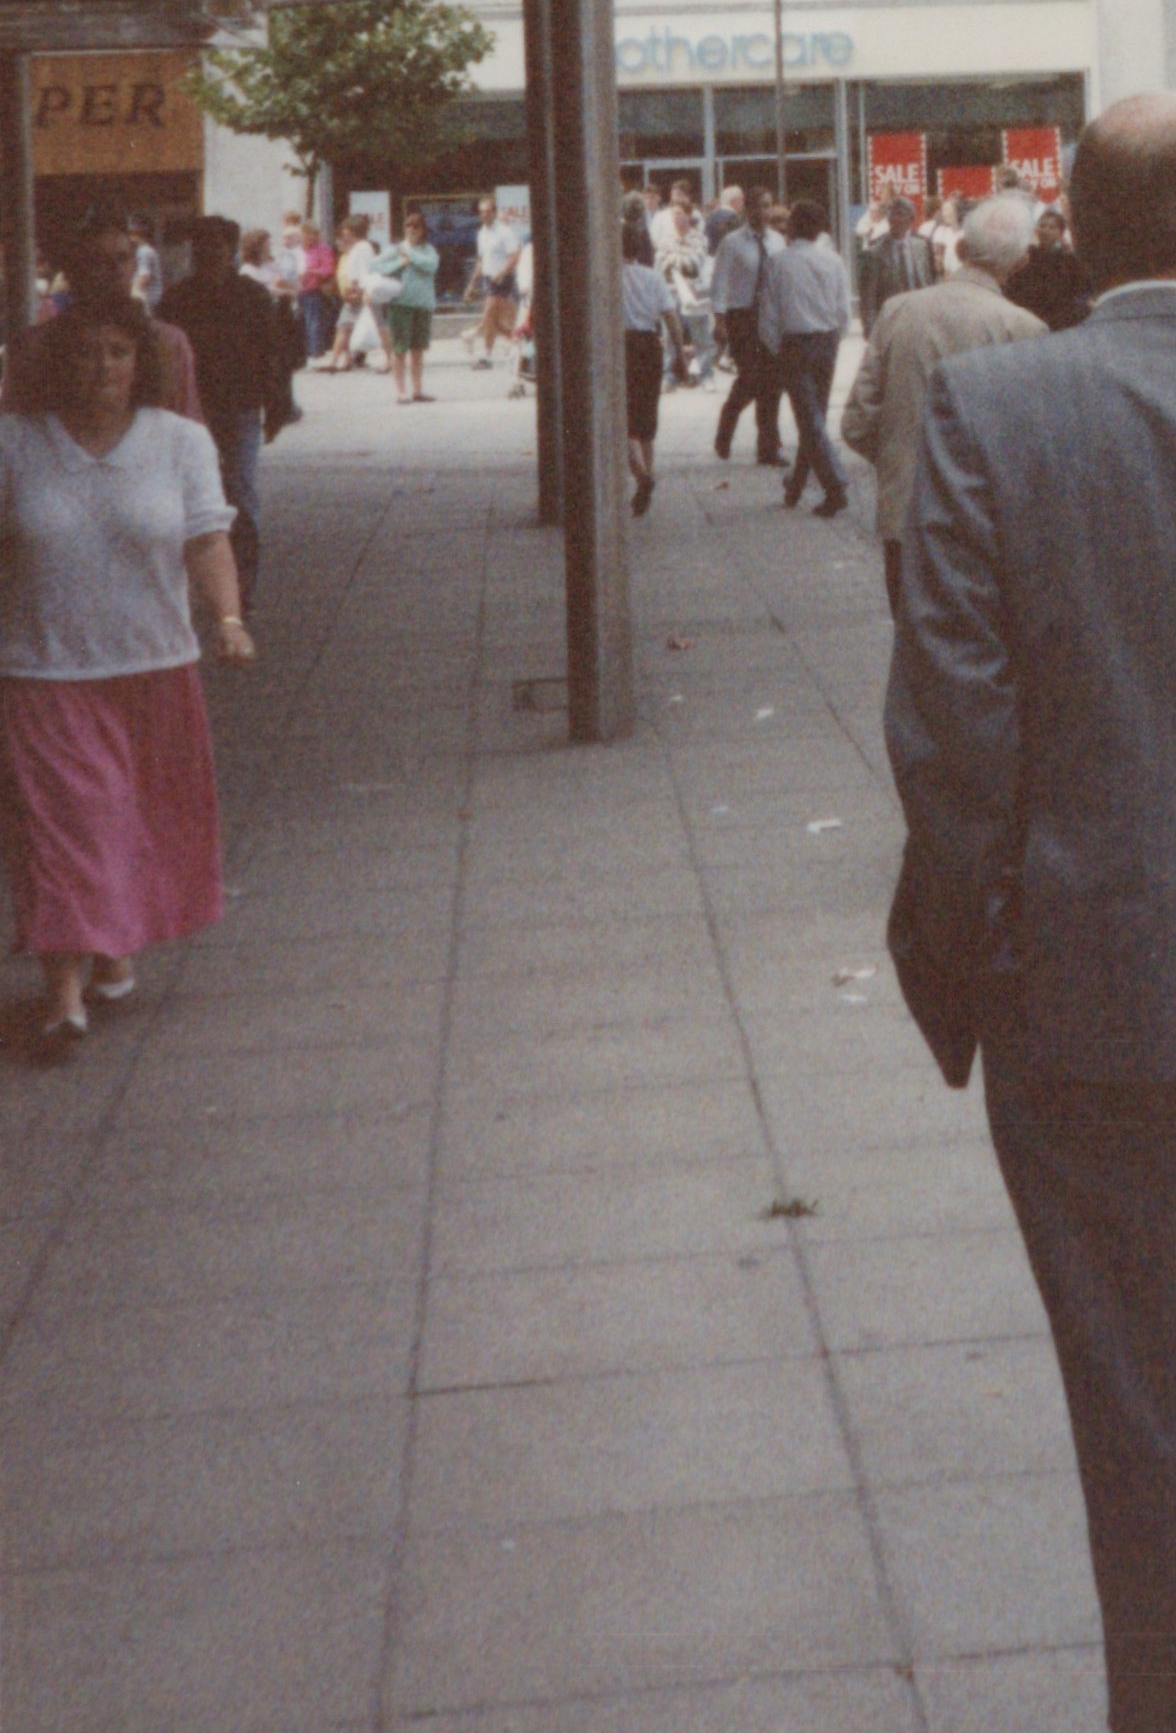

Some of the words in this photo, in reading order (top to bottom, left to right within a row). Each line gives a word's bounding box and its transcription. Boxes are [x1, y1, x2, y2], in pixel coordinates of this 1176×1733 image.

[616, 26, 854, 72] othercare
[35, 84, 166, 128] PER
[874, 163, 919, 183] SALE
